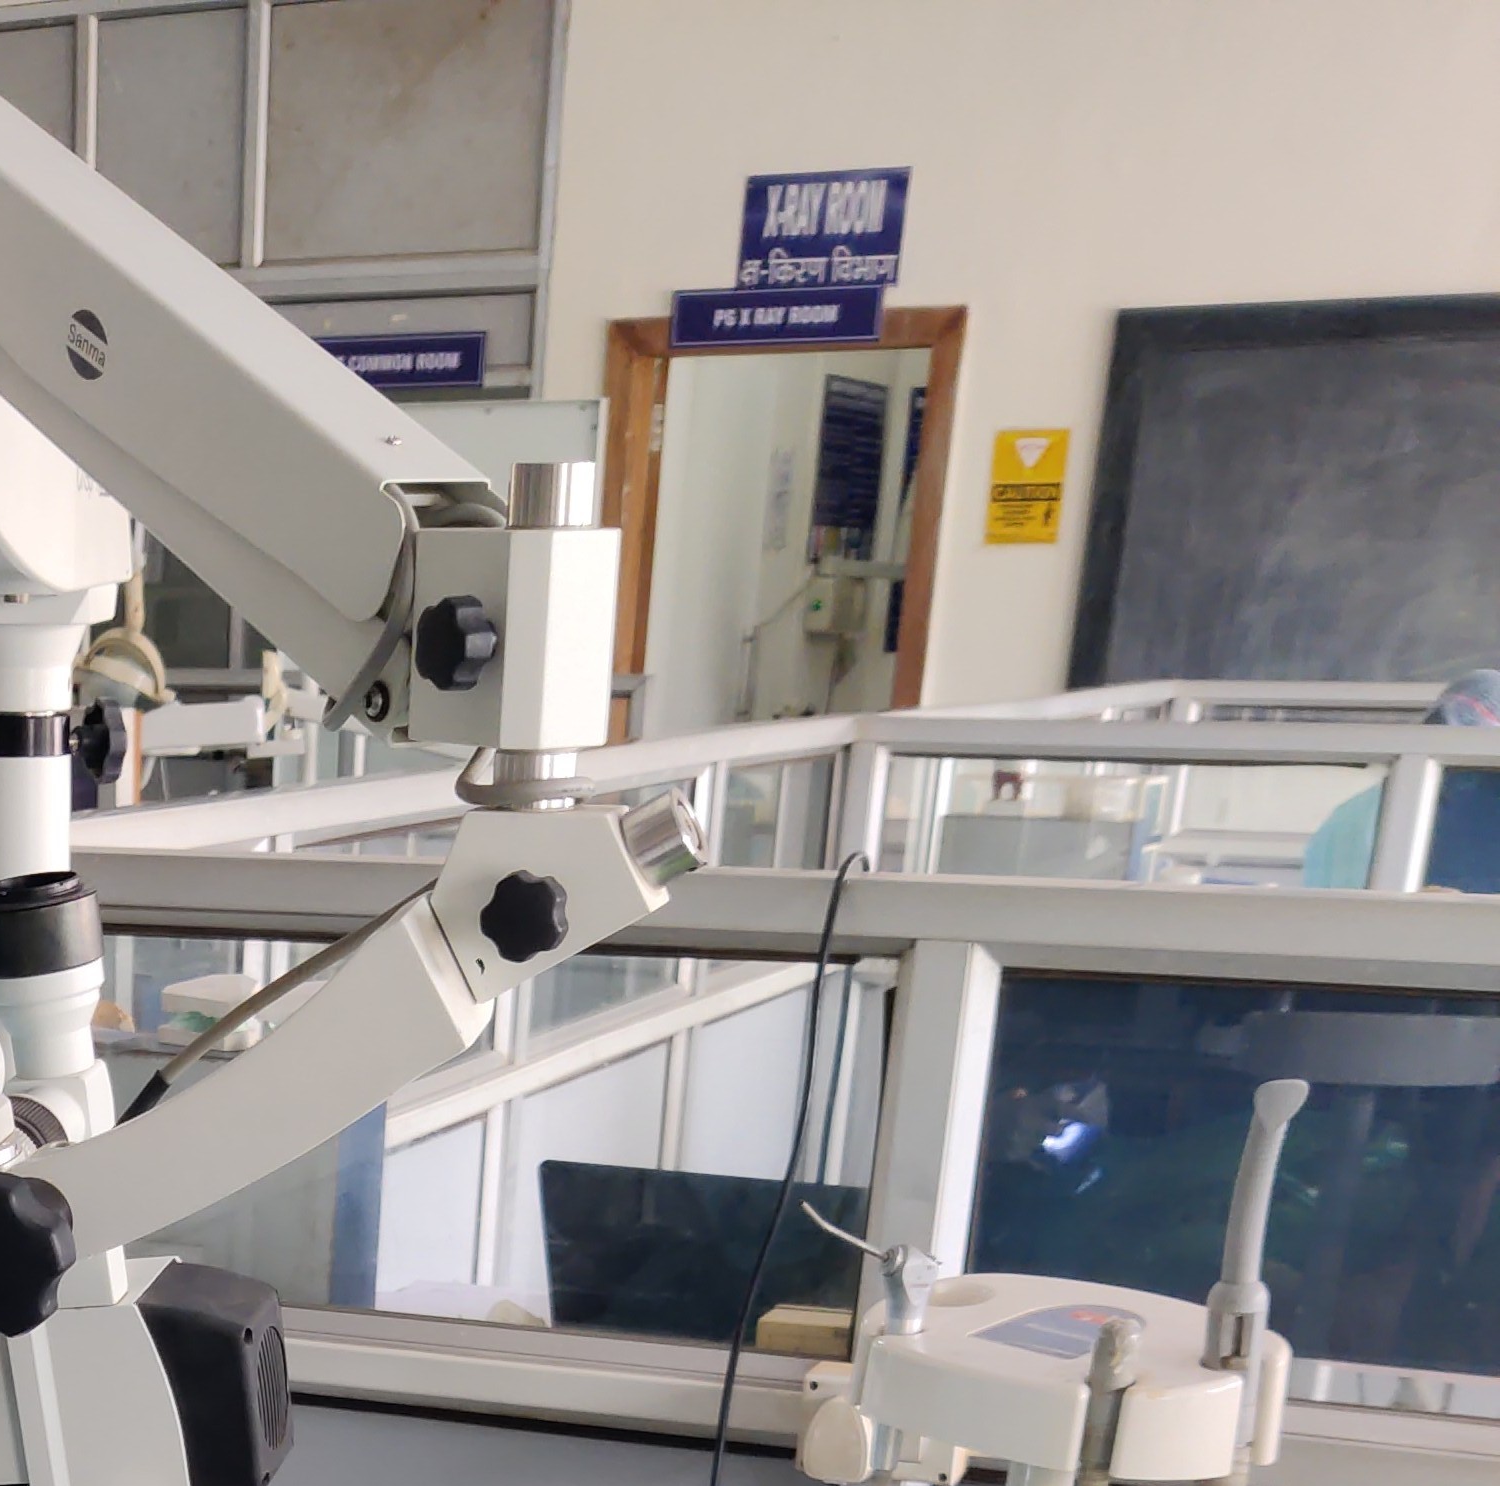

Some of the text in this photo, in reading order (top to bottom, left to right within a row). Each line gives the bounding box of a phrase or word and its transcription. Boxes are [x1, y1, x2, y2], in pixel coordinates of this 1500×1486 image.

[762, 179, 888, 239] X-RAY ROOM
[739, 307, 752, 326] X
[752, 306, 787, 325] RAY
[787, 304, 841, 323] ROOM
[68, 323, 106, 368] Sanma
[348, 354, 413, 371] COMMON
[415, 352, 461, 371] ROOM
